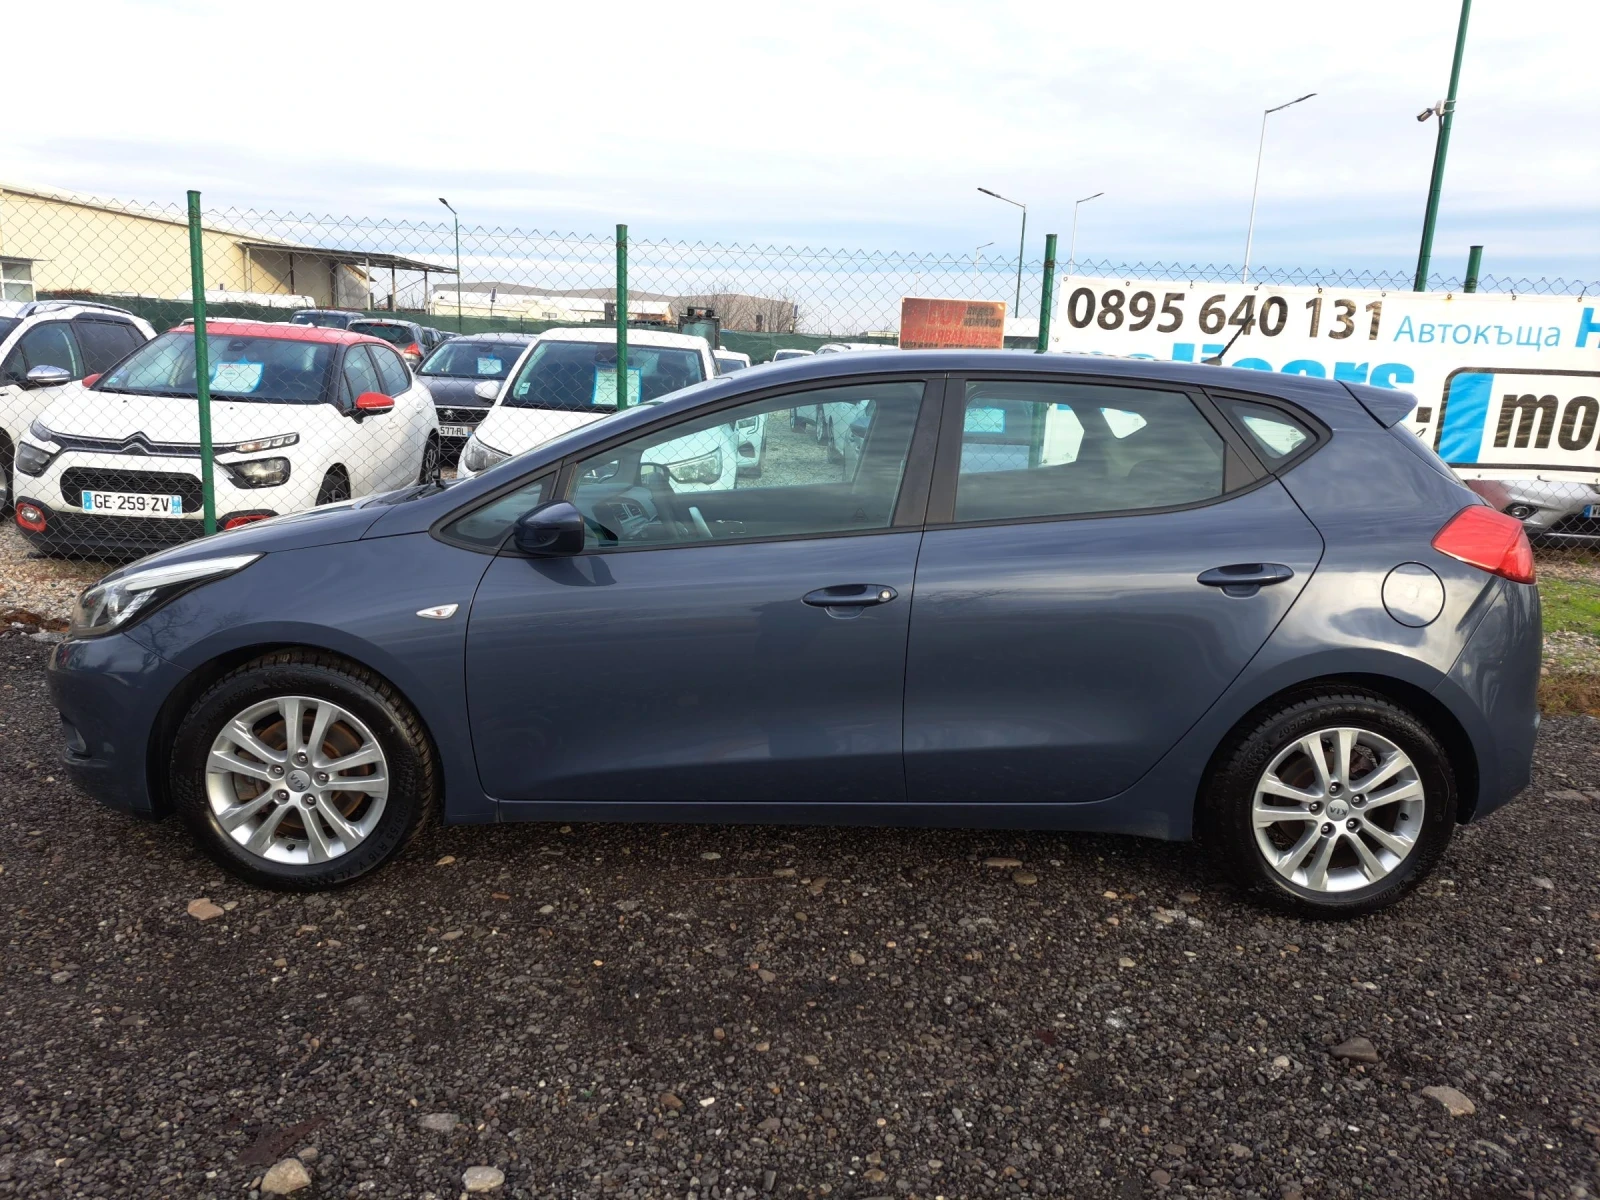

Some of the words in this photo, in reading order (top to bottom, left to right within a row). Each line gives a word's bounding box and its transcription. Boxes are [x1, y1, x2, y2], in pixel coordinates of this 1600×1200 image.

[1068, 285, 1184, 332] 0895
[1199, 294, 1289, 337] 640
[1306, 295, 1385, 339] 131
[1394, 316, 1561, 351] Автокъща
[1494, 394, 1600, 451] mo
[290, 773, 306, 790] KIA
[1330, 806, 1348, 816] KIA
